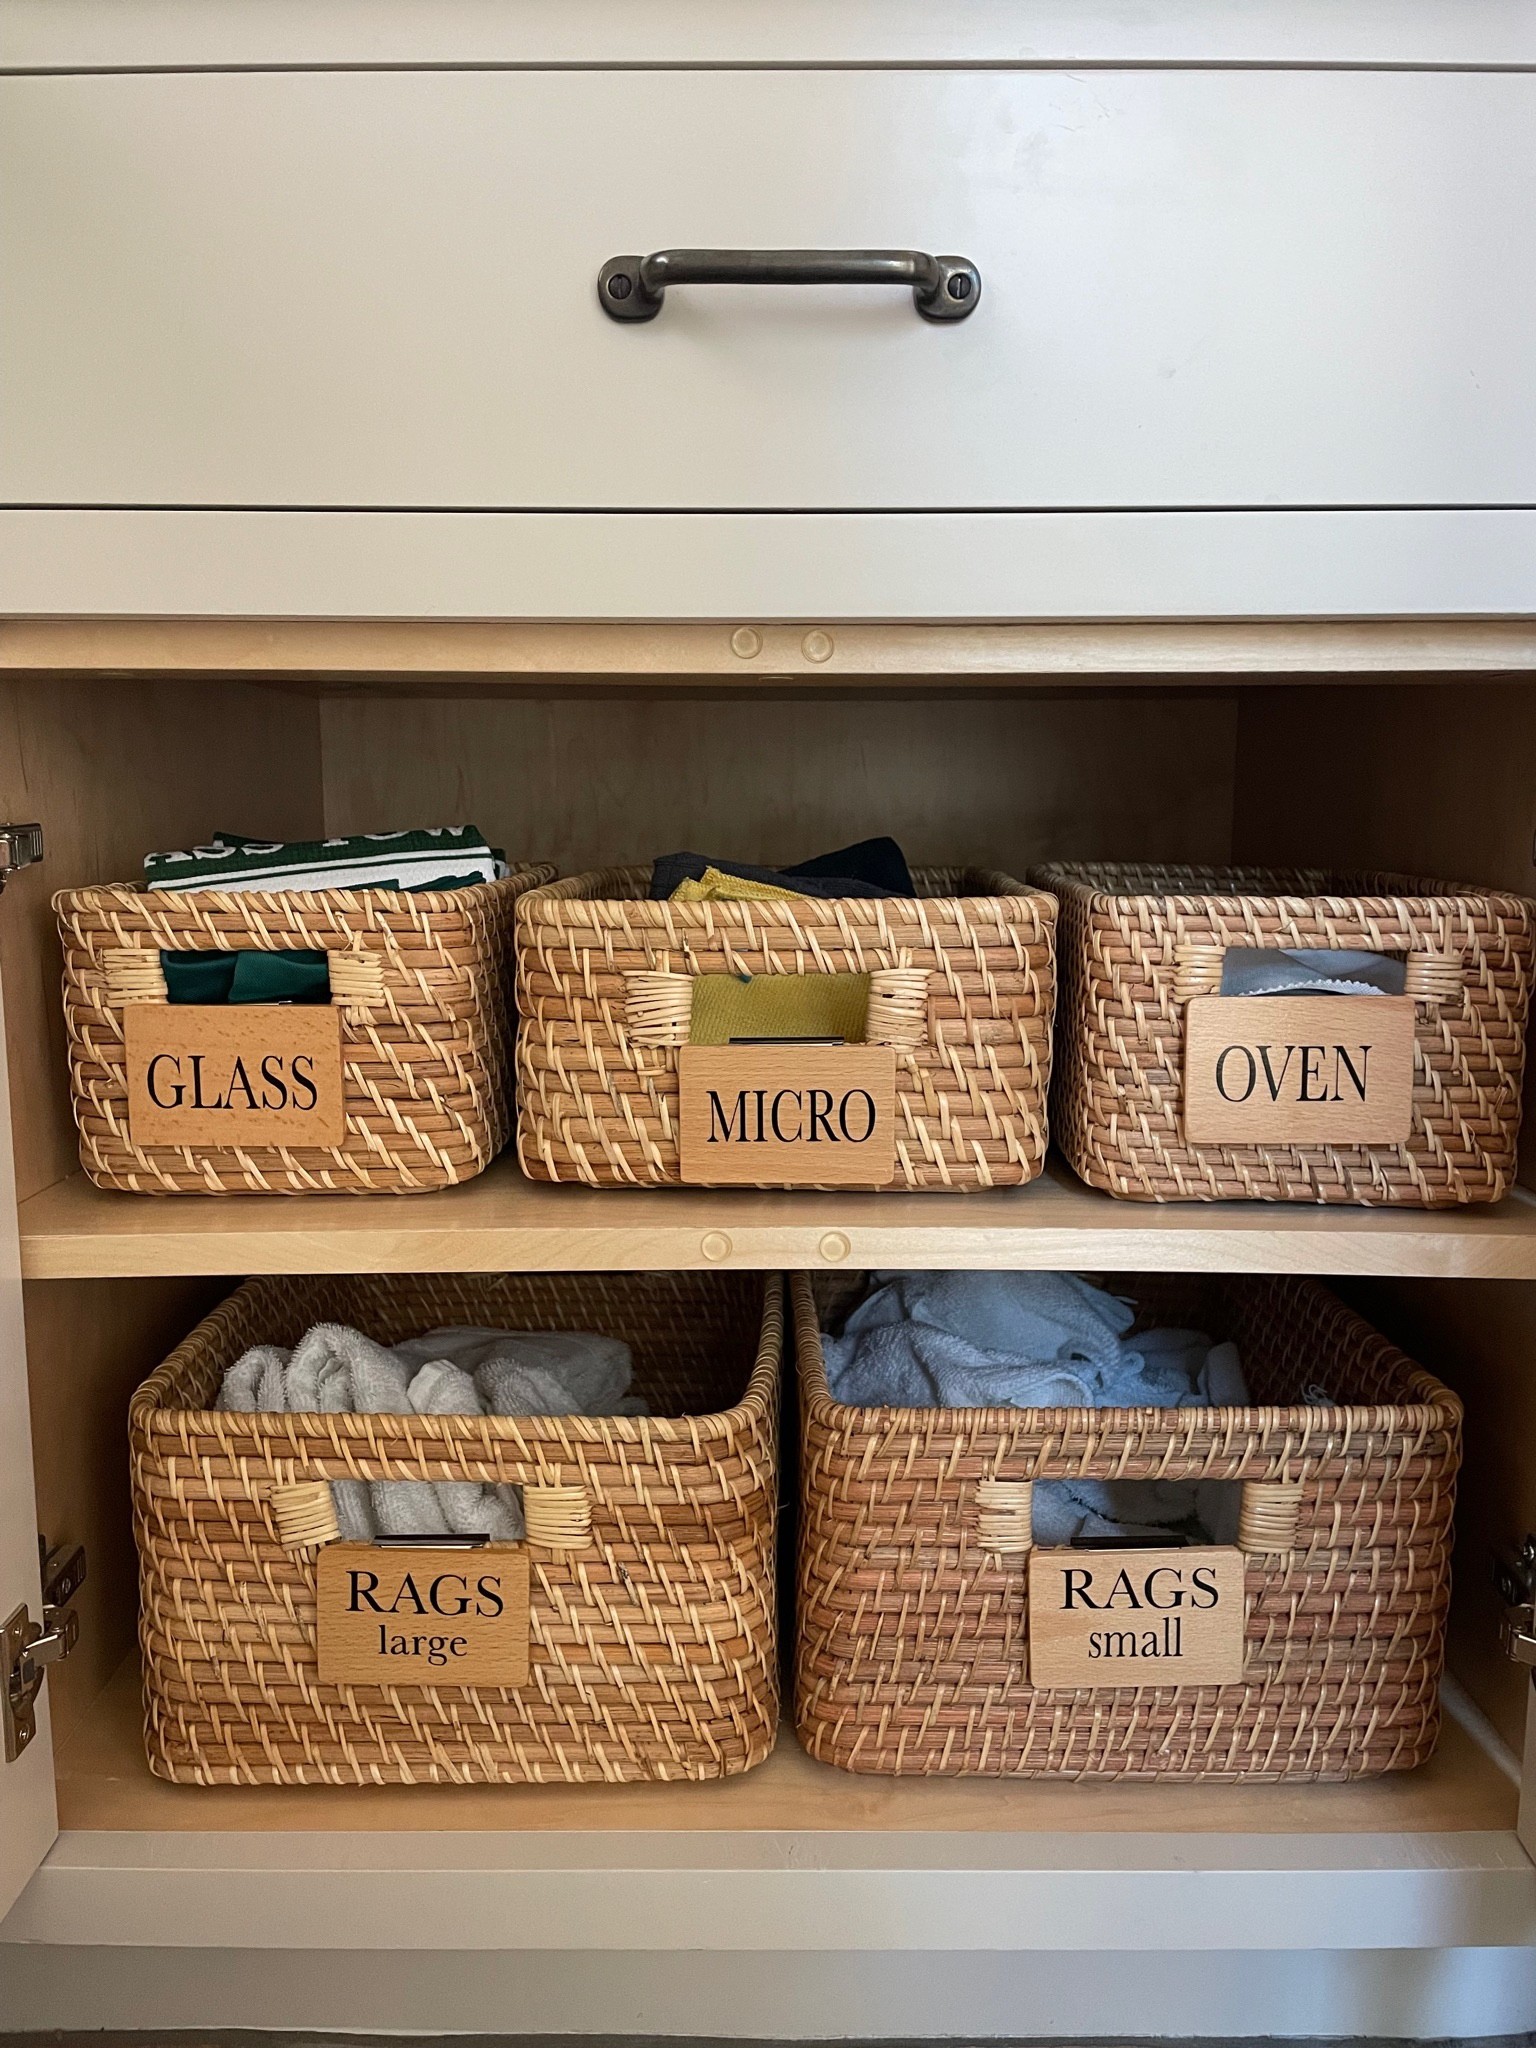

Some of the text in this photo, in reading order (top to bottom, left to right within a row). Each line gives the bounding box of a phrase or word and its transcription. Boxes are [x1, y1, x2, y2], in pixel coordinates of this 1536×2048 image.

[147, 1054, 318, 1111] GLASS
[1216, 1045, 1373, 1103] OVEN
[706, 1089, 876, 1143] MICRO
[345, 1570, 504, 1618] RAGS
[1059, 1567, 1219, 1610] RAGS
[378, 1625, 468, 1666] large
[1088, 1616, 1184, 1659] small
